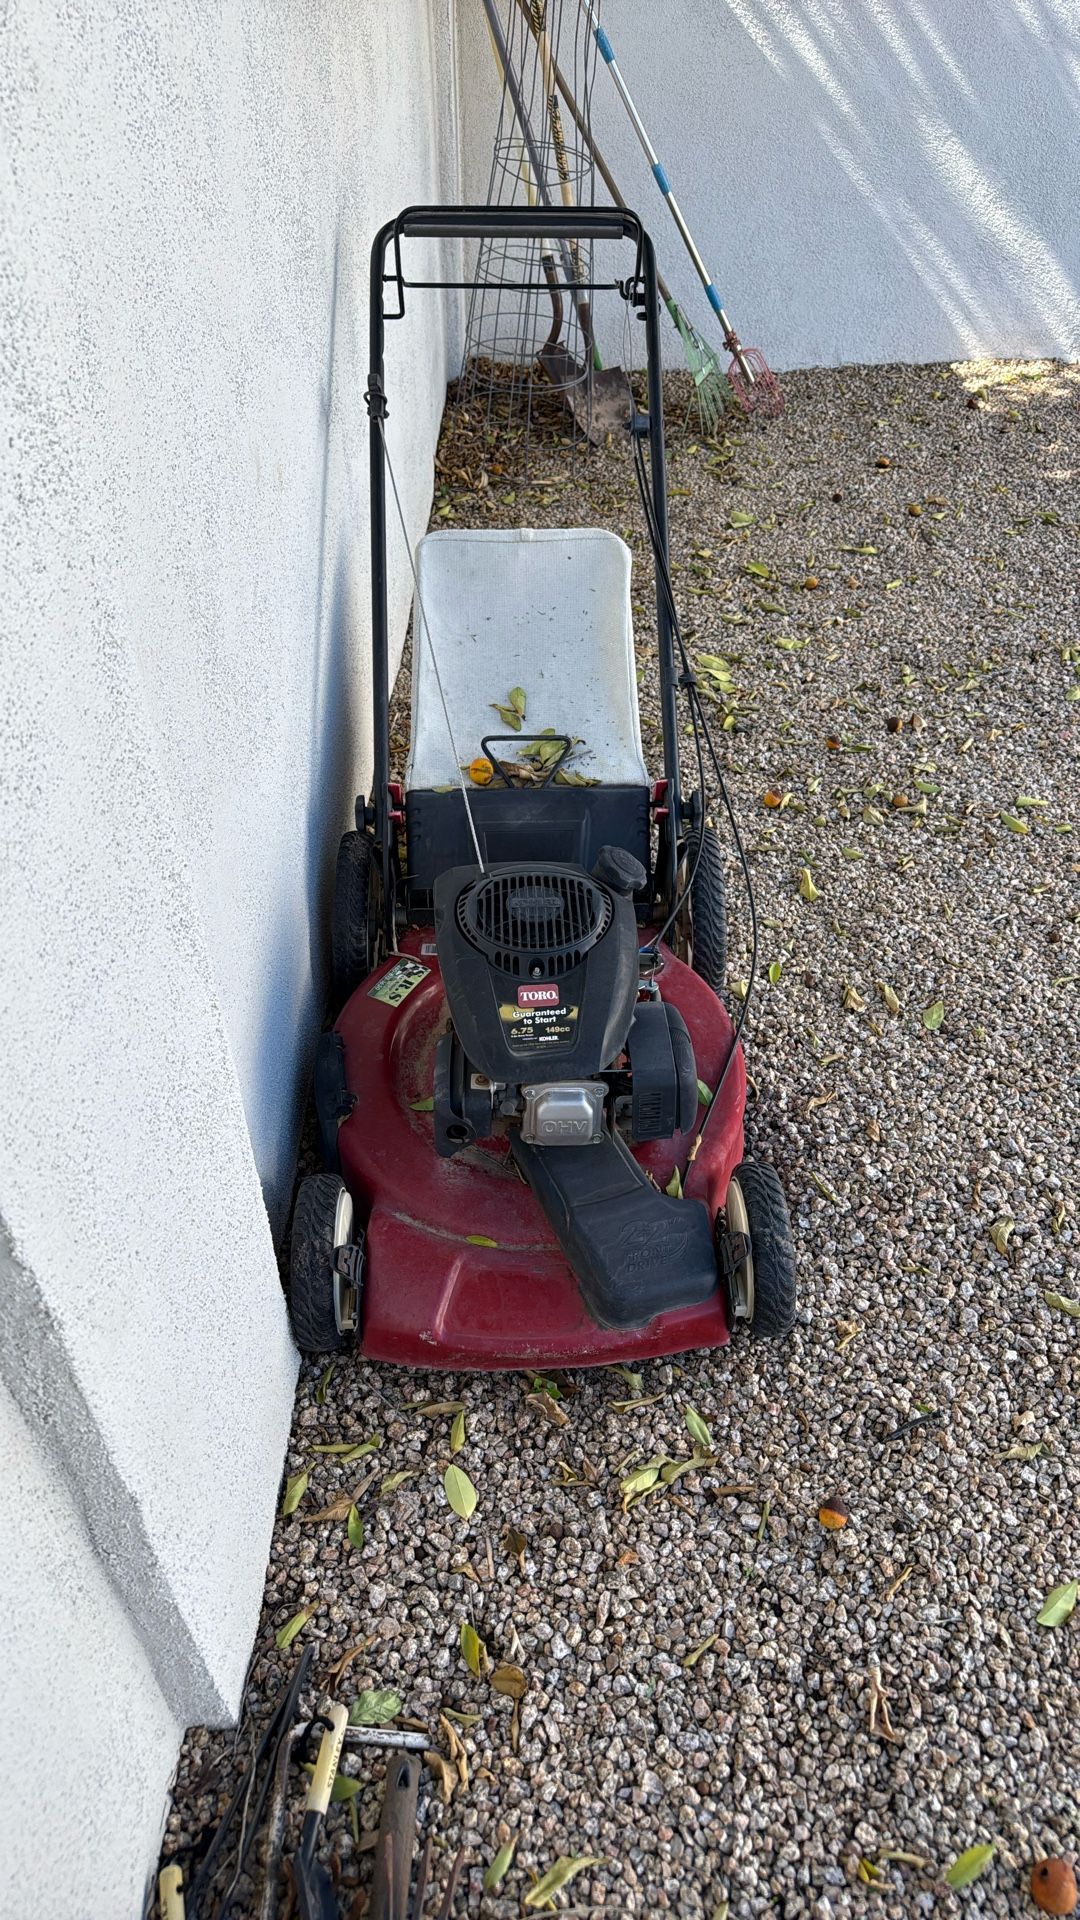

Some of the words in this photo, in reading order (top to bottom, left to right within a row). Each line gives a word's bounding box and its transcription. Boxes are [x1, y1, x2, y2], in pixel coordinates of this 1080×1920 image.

[512, 1007, 567, 1018] Guaranteed
[534, 1016, 557, 1024] Start
[510, 1026, 534, 1035] 6.75
[541, 1120, 588, 1134] OHV
[626, 1255, 667, 1273] DRIVE
[327, 1737, 342, 1788] STANLEY
